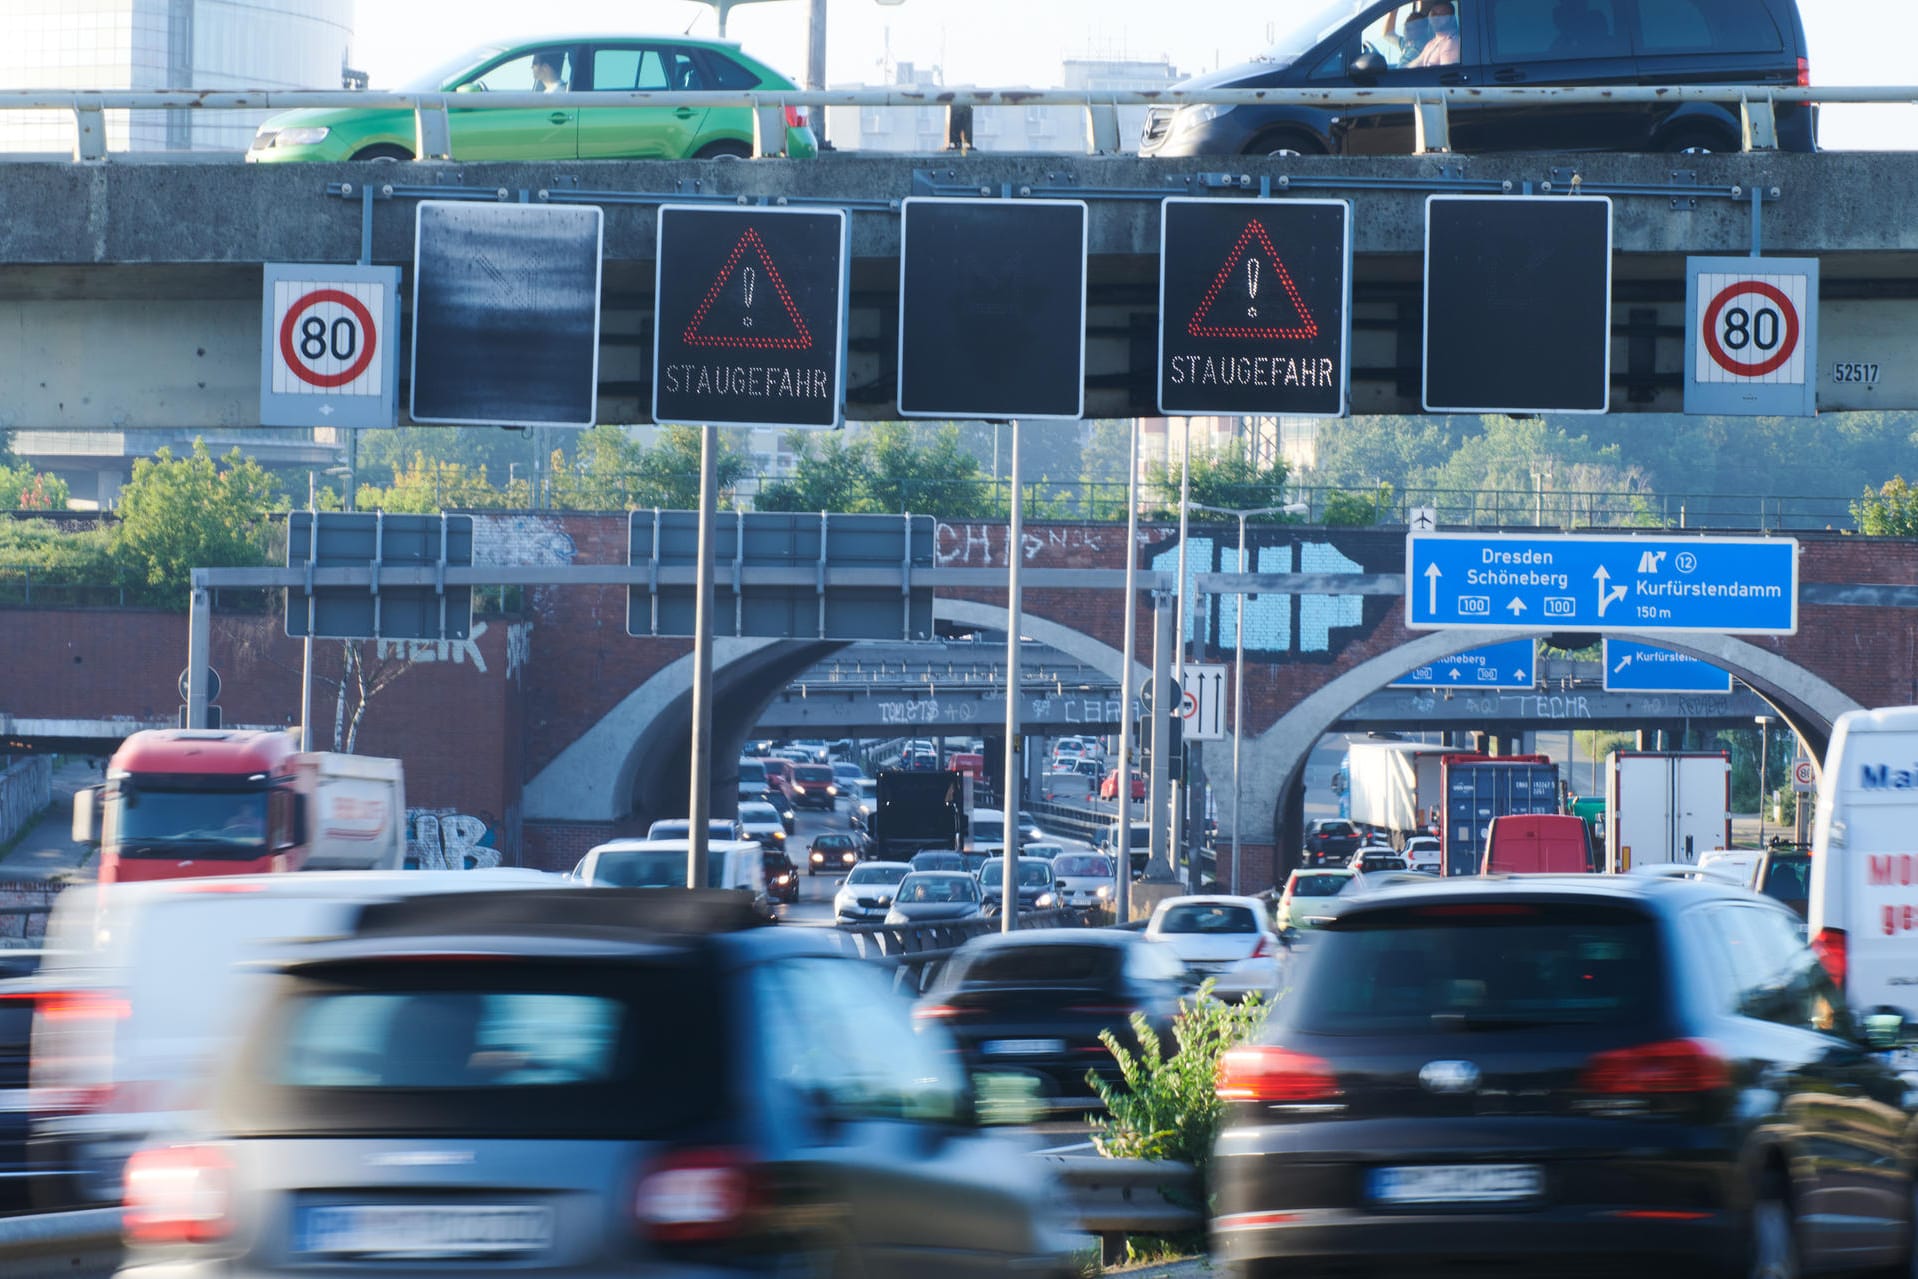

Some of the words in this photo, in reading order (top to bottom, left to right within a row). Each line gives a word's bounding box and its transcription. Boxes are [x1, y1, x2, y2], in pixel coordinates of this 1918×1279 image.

[300, 316, 356, 360] 80
[1723, 307, 1779, 350] 80
[665, 364, 828, 398] STAUGEFAHR
[1170, 355, 1334, 388] STAUGEFAHR
[1834, 363, 1879, 384] 52517
[1481, 548, 1553, 565] Dresden
[1680, 556, 1693, 570] 12
[1467, 569, 1568, 590] Schöneberg
[1636, 580, 1781, 598] Kurfürstendamm
[1463, 599, 1485, 613] 100
[1549, 600, 1571, 614] 100
[1637, 605, 1657, 618] 150
[1659, 608, 1671, 618] m
